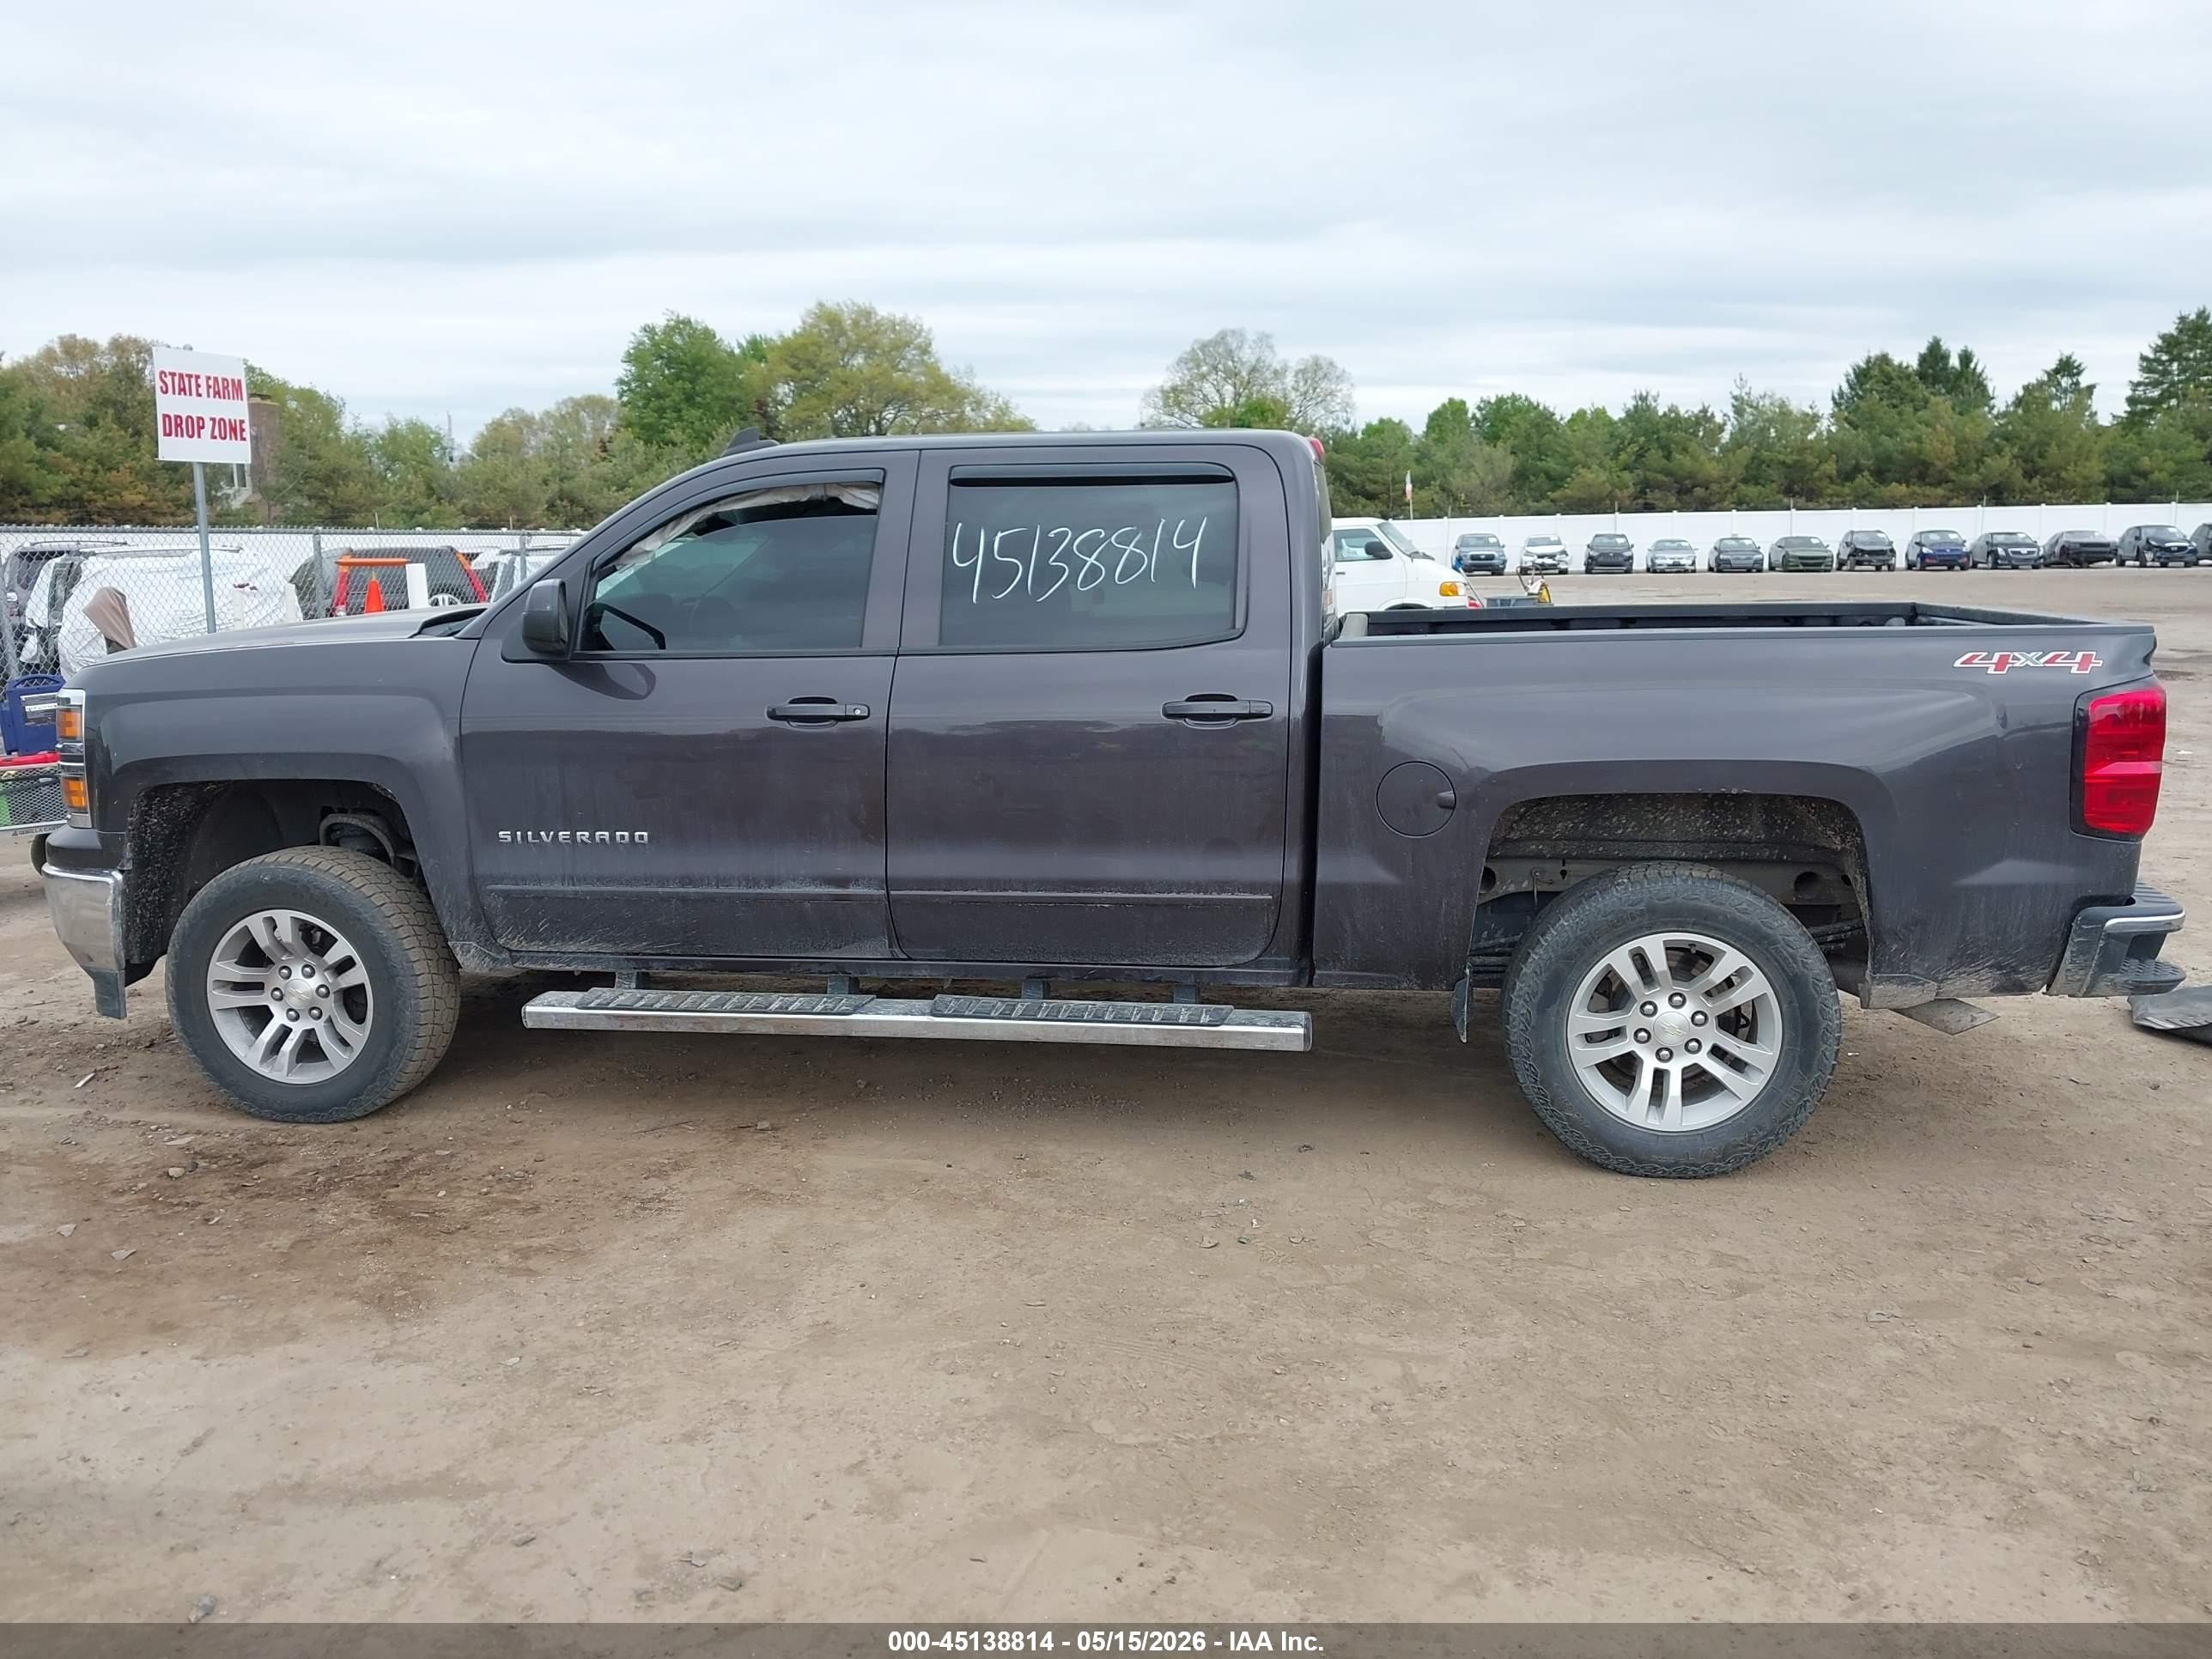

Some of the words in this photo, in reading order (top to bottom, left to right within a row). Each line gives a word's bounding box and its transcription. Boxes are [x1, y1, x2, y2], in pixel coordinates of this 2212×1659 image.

[159, 370, 202, 398] STATE
[205, 375, 244, 402] FARM
[162, 413, 205, 439] DROP
[210, 417, 247, 441] ZONE
[951, 516, 1207, 604] 45138814
[498, 830, 648, 844] SILVERADO
